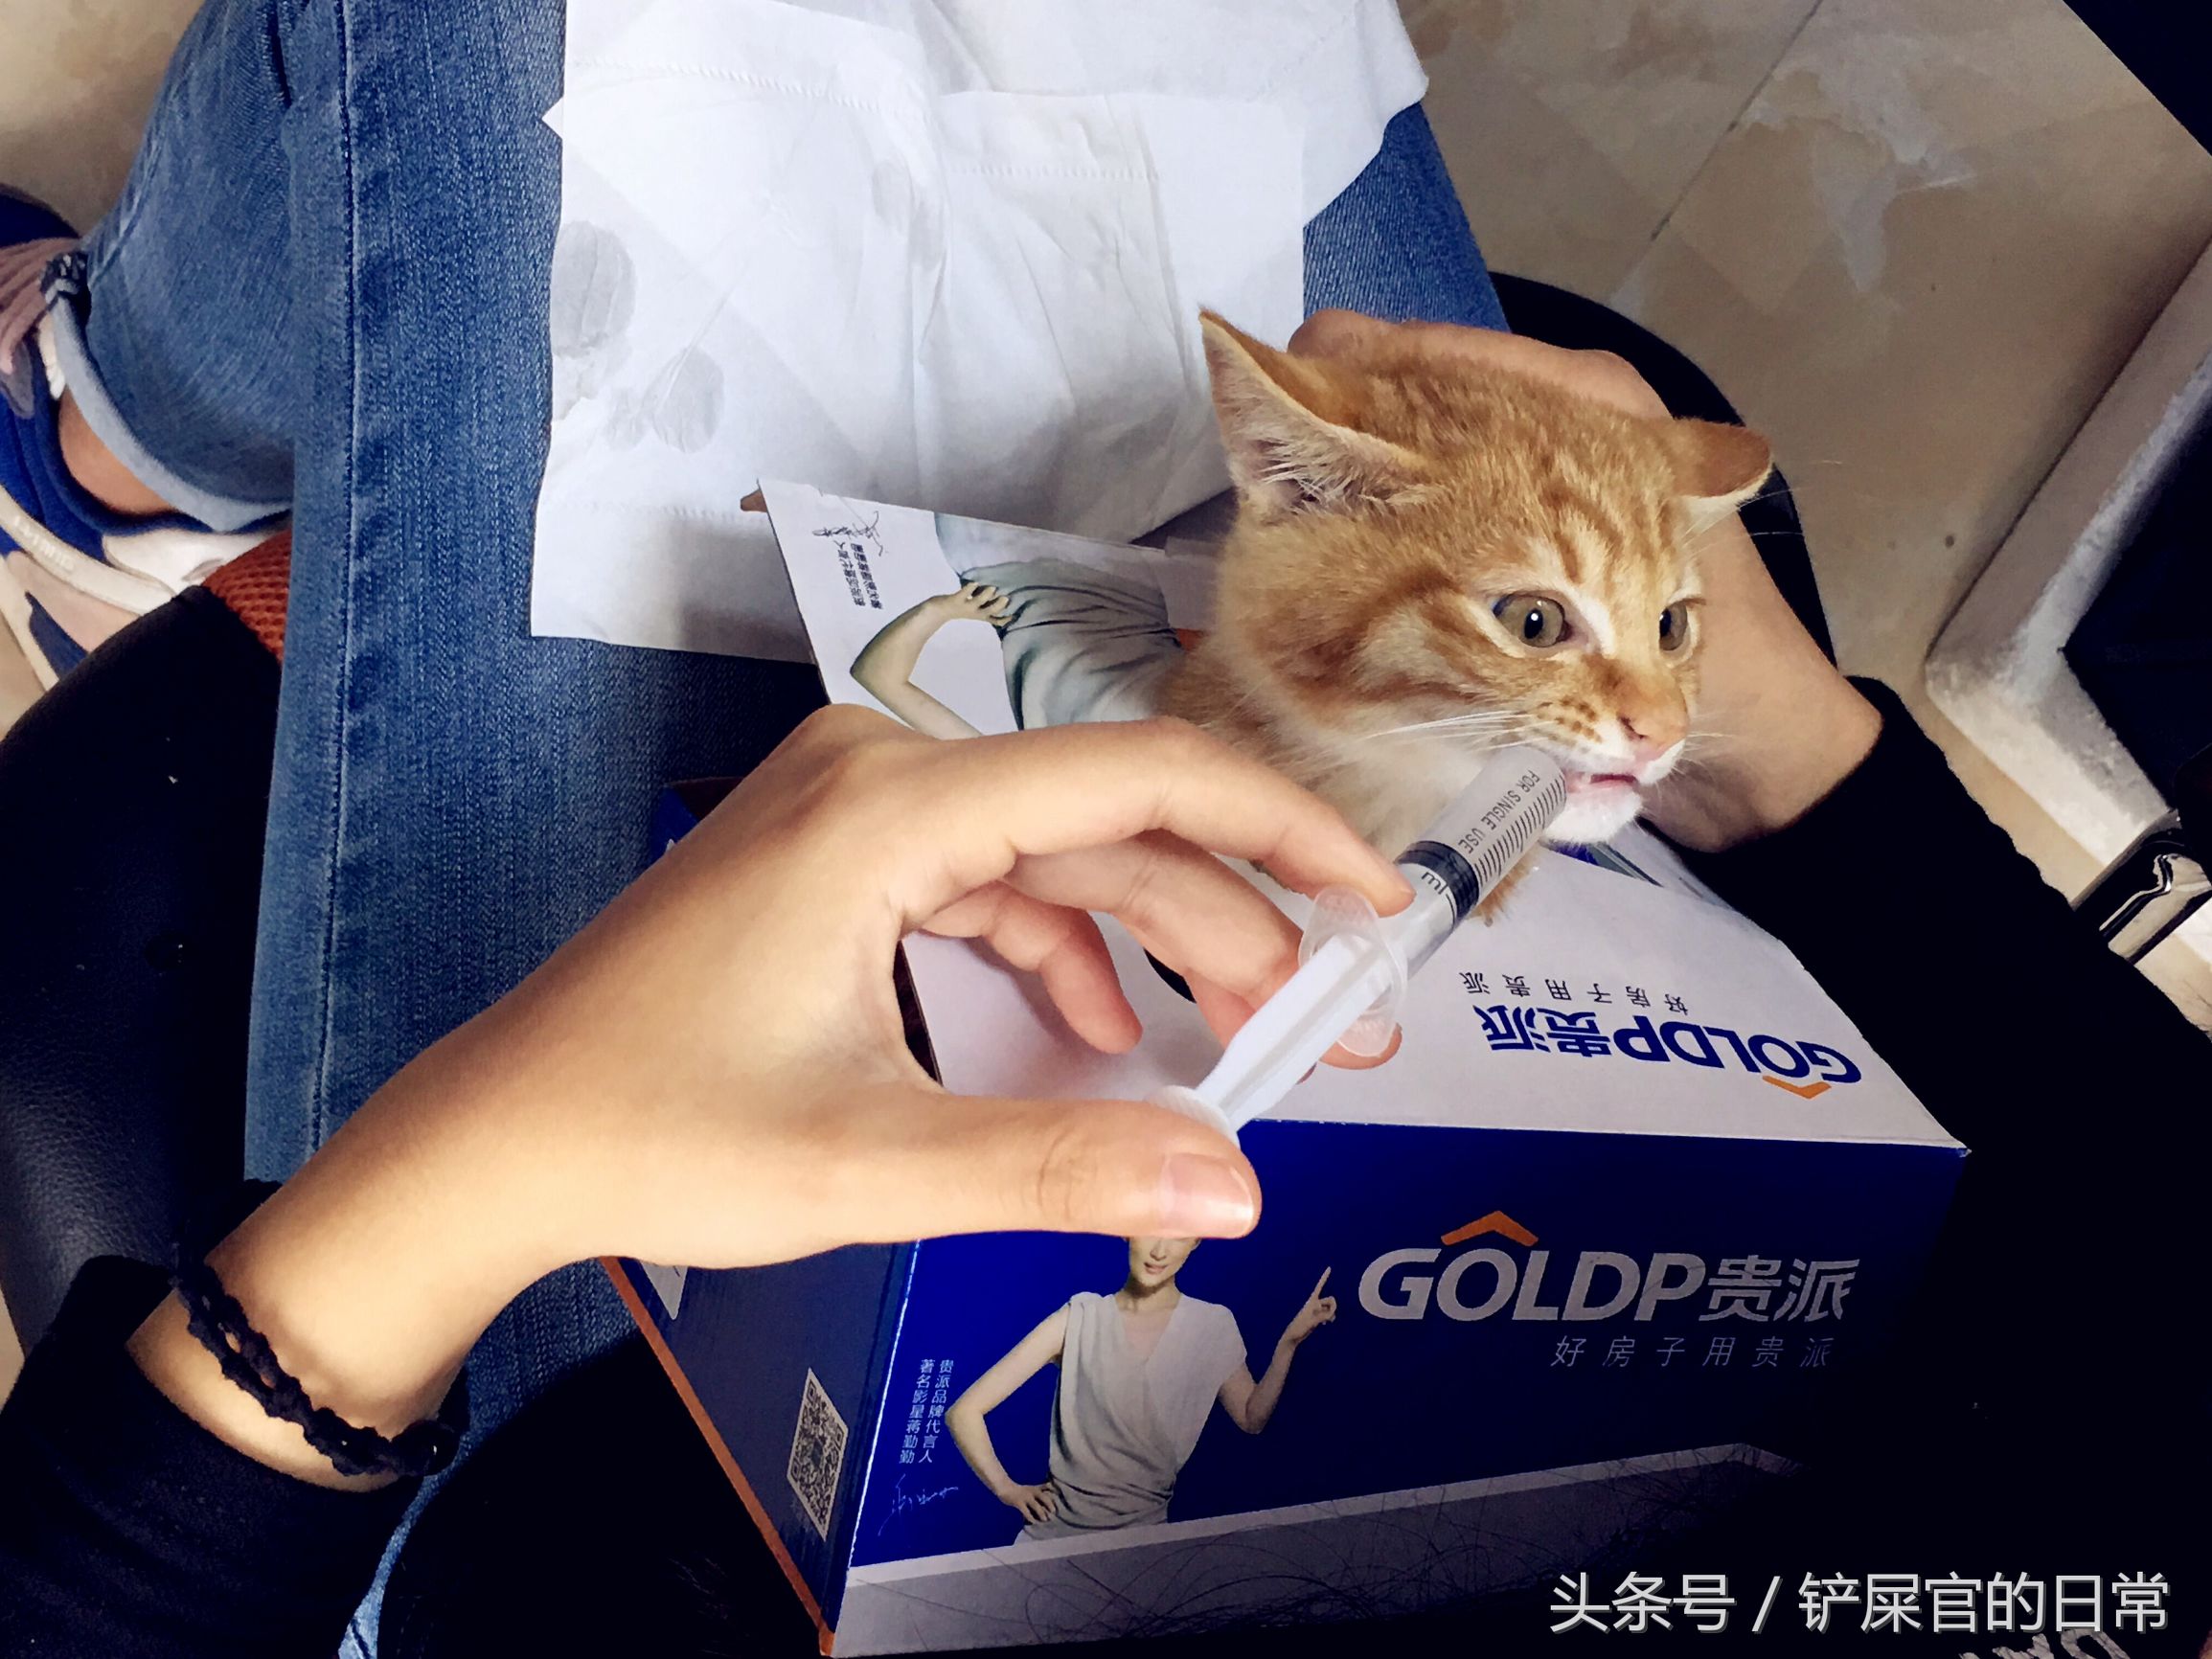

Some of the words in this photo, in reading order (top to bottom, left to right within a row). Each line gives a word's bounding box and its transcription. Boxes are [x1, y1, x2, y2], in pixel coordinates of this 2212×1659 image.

[1516, 769, 1540, 794] FOR
[1480, 789, 1521, 830] SINGLE
[1457, 827, 1486, 854] USE
[1458, 971, 1689, 1016] 好房子用贵派
[1550, 1334, 1836, 1369] 好房子用贵派
